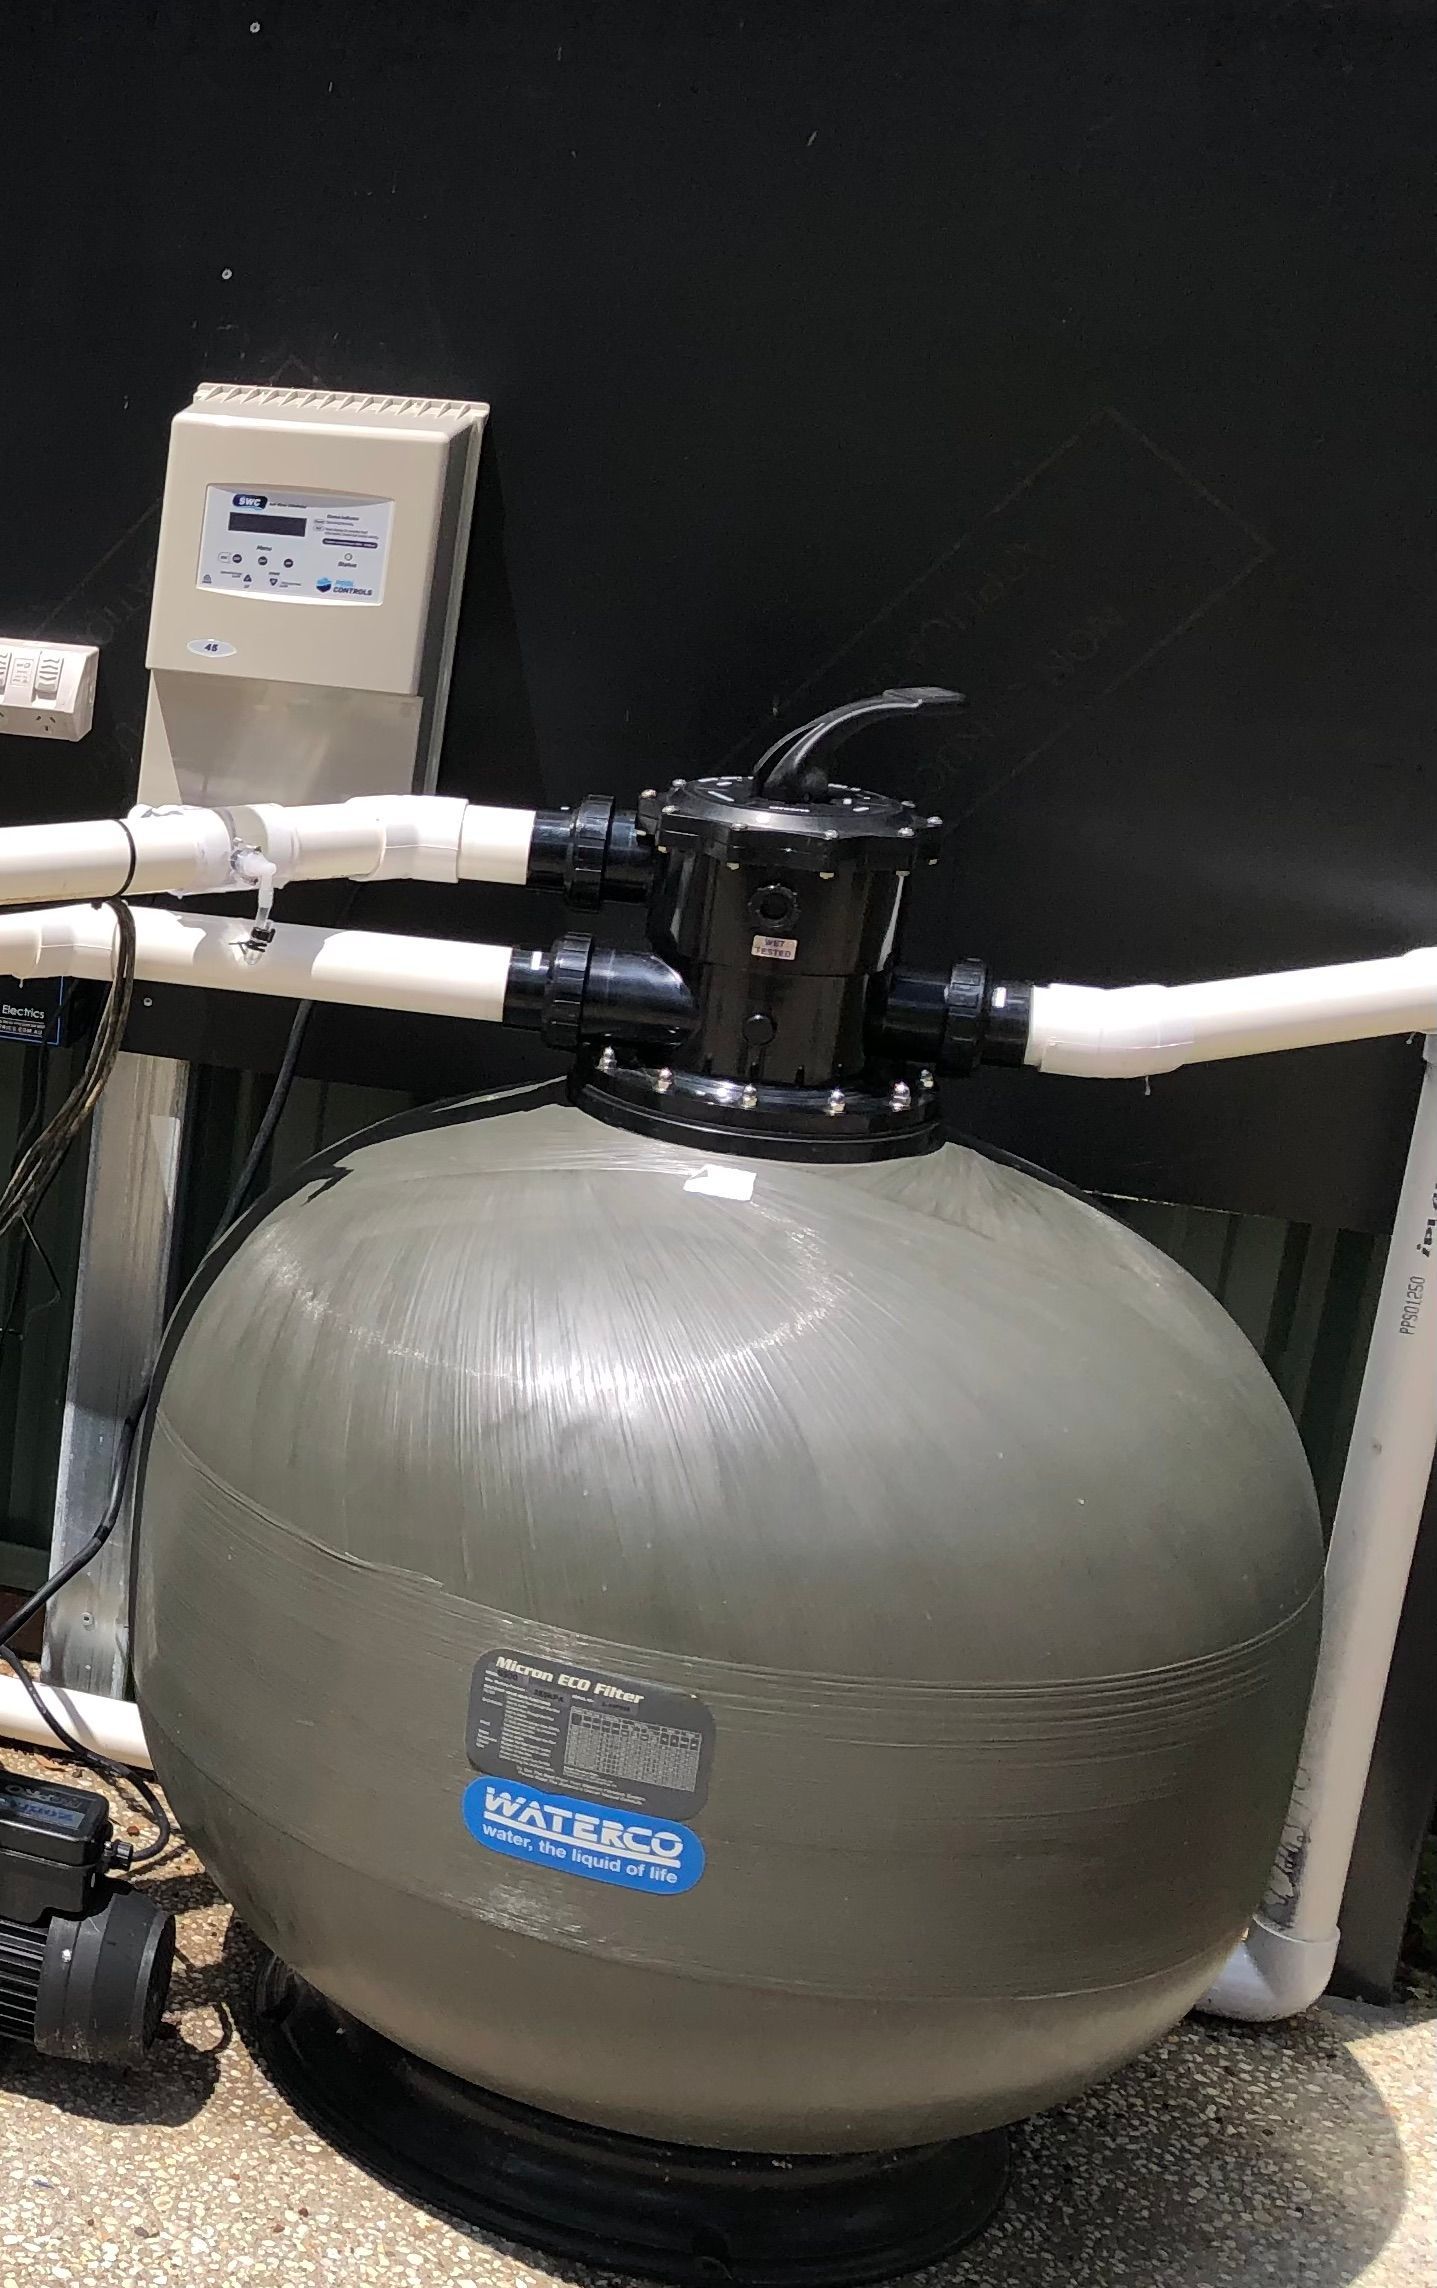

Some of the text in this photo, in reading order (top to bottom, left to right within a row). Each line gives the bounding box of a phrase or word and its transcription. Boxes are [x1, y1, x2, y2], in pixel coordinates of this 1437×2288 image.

[238, 496, 261, 506] SWC
[333, 587, 373, 596] CONTROLS
[204, 643, 218, 652] 45
[754, 946, 791, 958] TESTED
[2, 1004, 45, 1019] Electrics
[495, 1656, 554, 1684] Micron
[557, 1674, 592, 1692] ECO
[593, 1683, 645, 1704] Filter
[483, 1786, 684, 1859] WATERCO
[482, 1823, 678, 1884] water, the liquid of life
